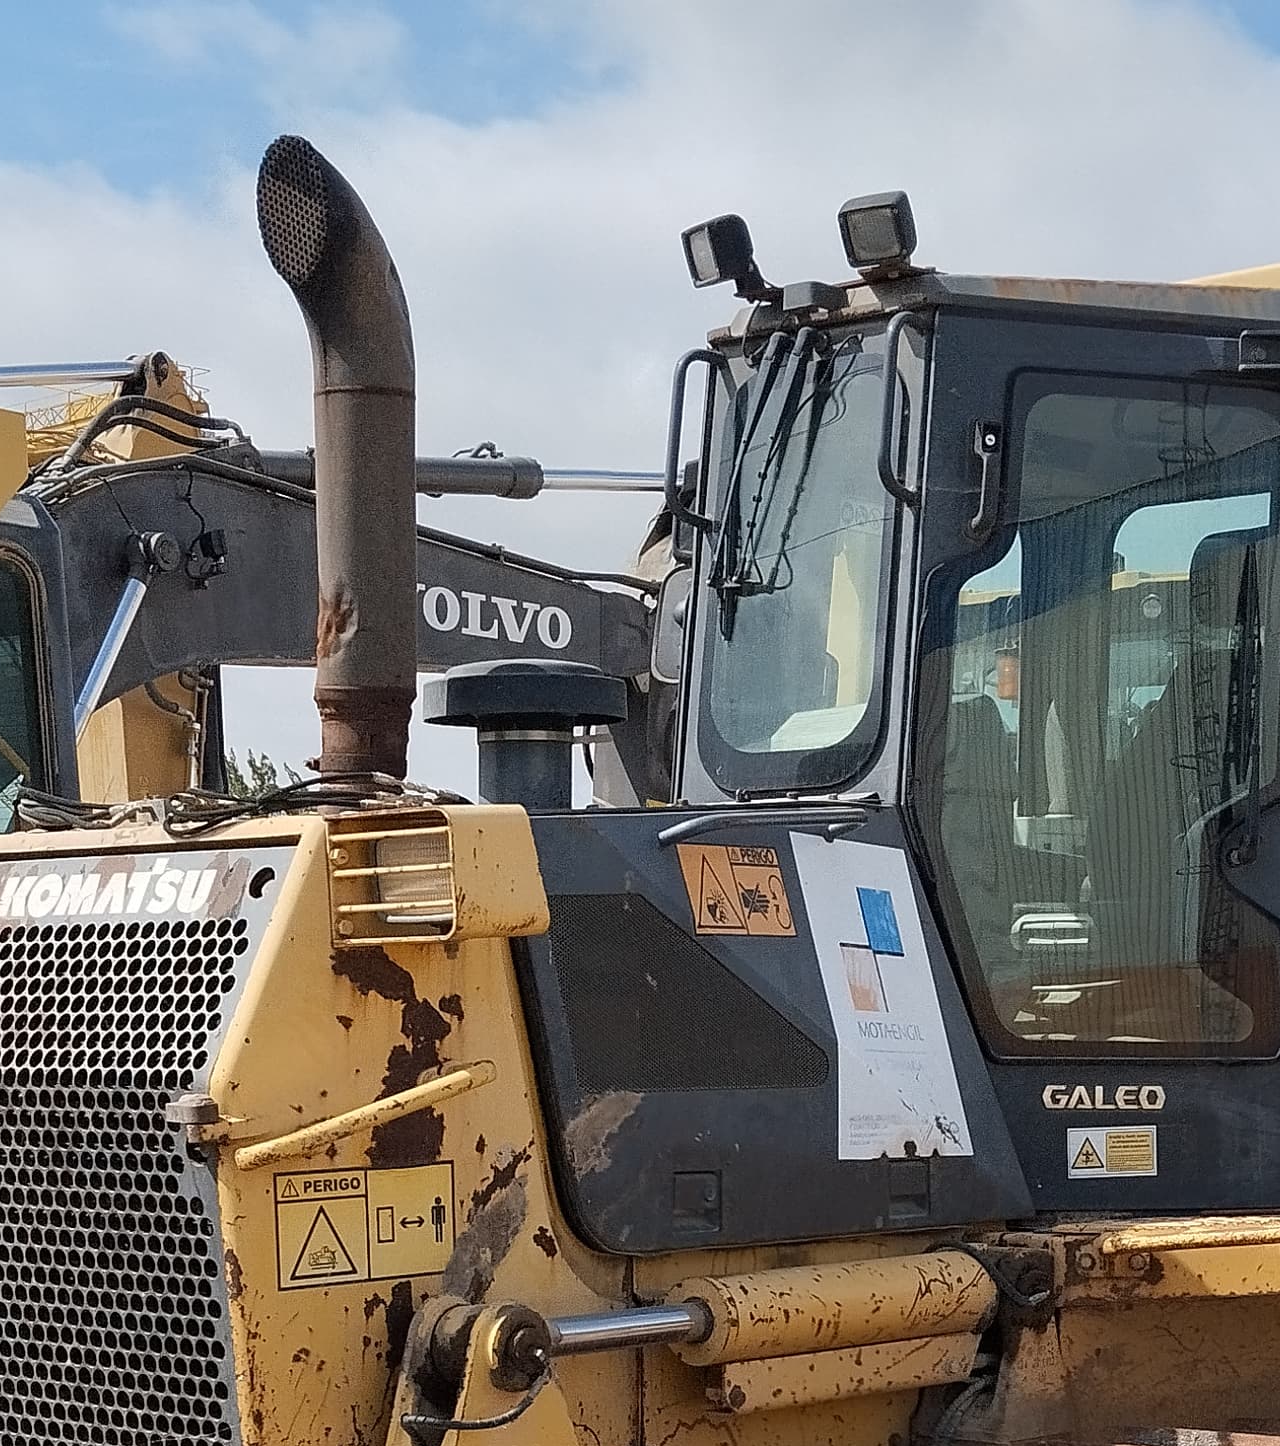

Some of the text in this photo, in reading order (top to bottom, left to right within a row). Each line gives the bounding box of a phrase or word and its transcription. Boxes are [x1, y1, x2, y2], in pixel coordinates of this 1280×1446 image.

[417, 583, 573, 650] OLVO
[740, 848, 775, 865] PERIGO
[1042, 1085, 1166, 1110] GALEO
